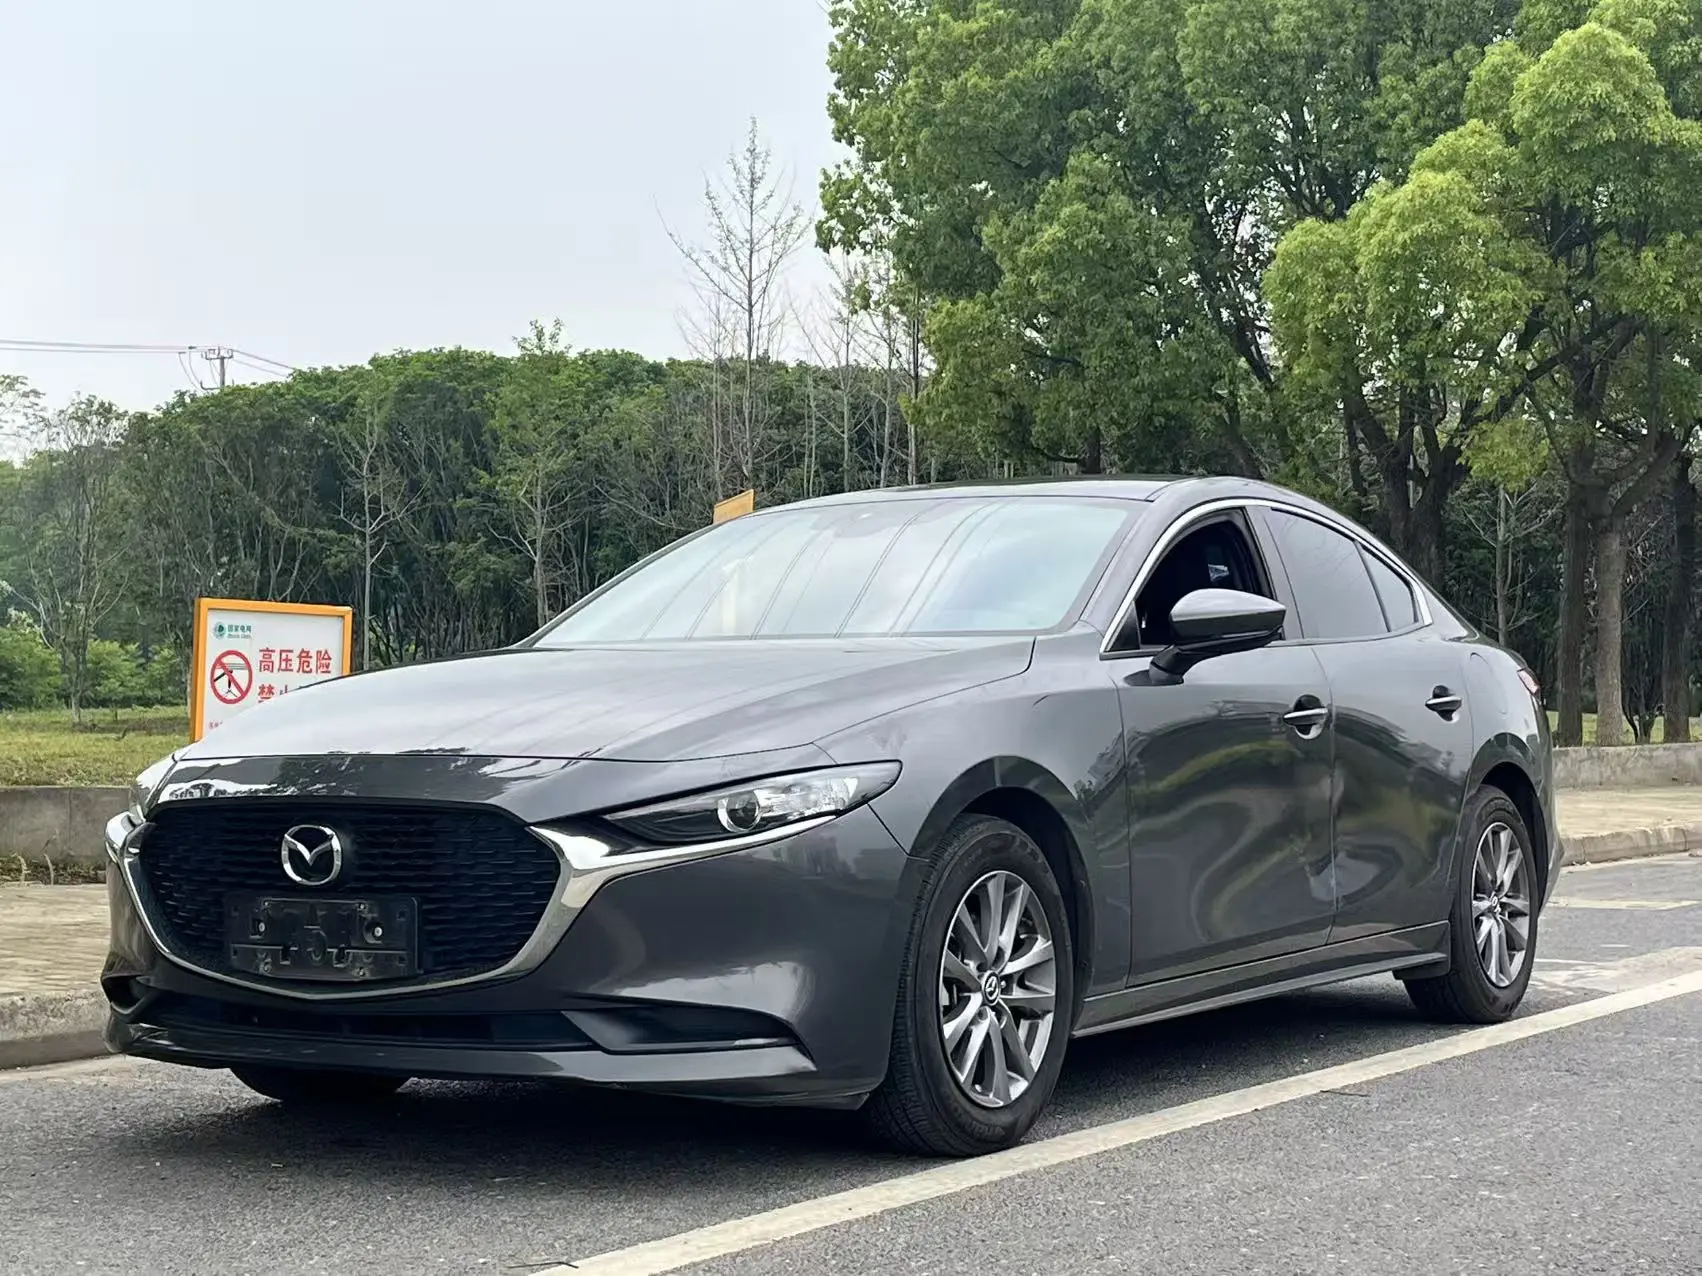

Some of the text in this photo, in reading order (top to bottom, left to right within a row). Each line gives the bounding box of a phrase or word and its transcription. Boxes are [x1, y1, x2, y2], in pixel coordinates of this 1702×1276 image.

[259, 647, 332, 674] 高压危险
[258, 684, 288, 703] 禁
